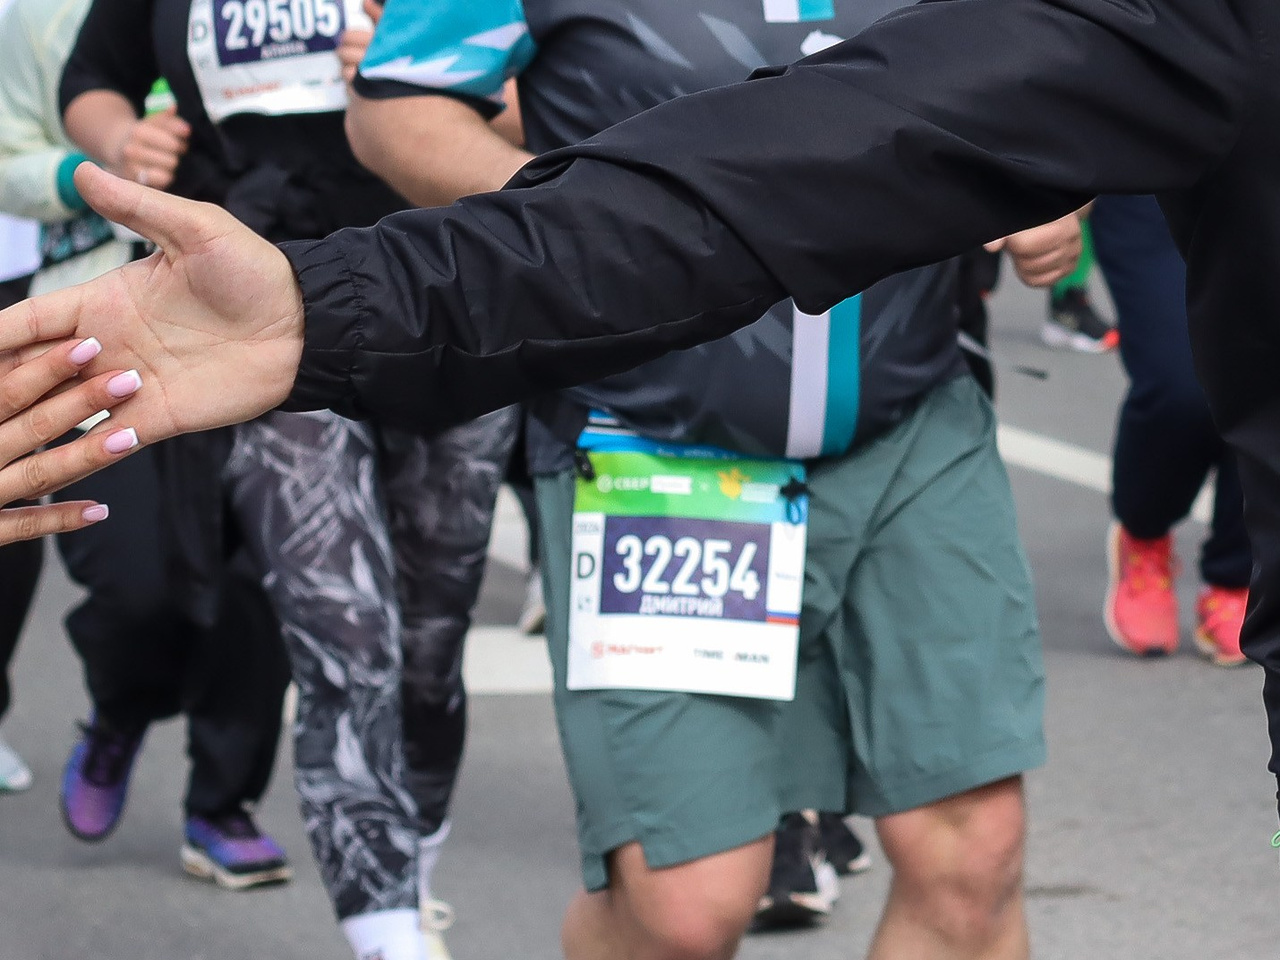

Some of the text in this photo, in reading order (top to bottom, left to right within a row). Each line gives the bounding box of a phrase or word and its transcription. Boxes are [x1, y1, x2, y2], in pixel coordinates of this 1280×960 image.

[577, 552, 596, 579] D
[613, 534, 761, 601] 32254
[639, 595, 724, 617] ДМИТРИЙ
